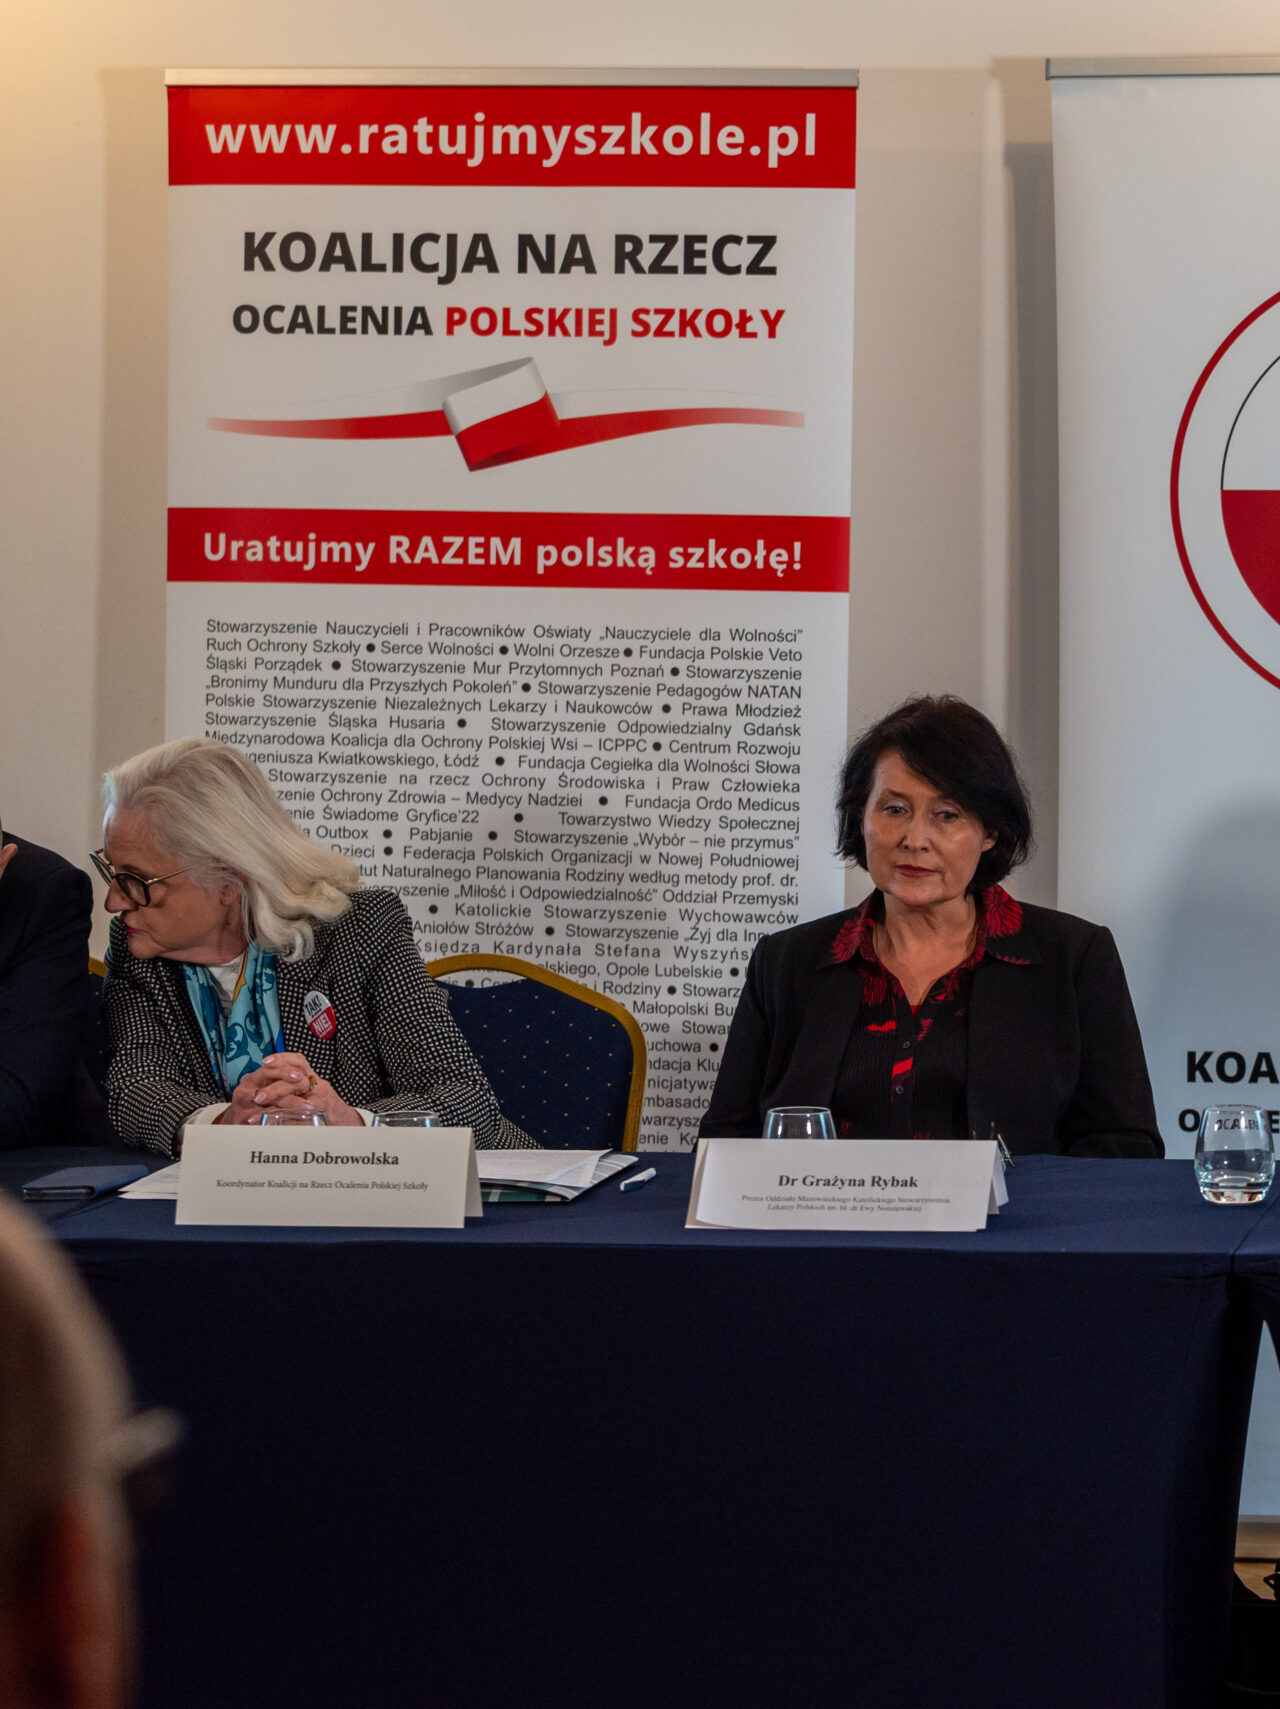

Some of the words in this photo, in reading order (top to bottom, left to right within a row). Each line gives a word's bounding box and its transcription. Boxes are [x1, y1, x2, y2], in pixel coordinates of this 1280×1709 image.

[204, 113, 818, 168] www.ratujmyszkole.pl
[243, 231, 500, 285] KOALICJA
[515, 233, 597, 276] NA
[613, 233, 778, 276] RZECZ
[232, 304, 433, 336] OCALENIA
[446, 306, 619, 346] POLSKIEJ
[630, 307, 786, 339] SZKOŁY
[203, 533, 376, 572] Uratujmy
[389, 535, 523, 566] RAZEM
[536, 537, 657, 576] polską
[667, 540, 803, 577] szkołę!
[207, 619, 317, 636] Stowarzyszenie
[326, 621, 408, 638] Nauczycieli
[429, 623, 525, 638] Pracowników
[534, 624, 591, 642] Oświaty
[700, 628, 720, 641] dla
[207, 638, 241, 651] Ruch
[247, 638, 308, 656] Ochrony
[313, 639, 361, 657] Szkoły
[381, 640, 423, 655] Serce
[428, 642, 494, 656] Wolności
[514, 643, 554, 656] Wolni
[560, 644, 620, 658] Orzesze
[640, 645, 704, 663] Fundacja
[711, 646, 763, 661] Polskie
[768, 648, 802, 662] Veto
[206, 654, 246, 673] Śląski
[255, 657, 322, 674] Porządek
[352, 658, 466, 676] Stowarzyszenie
[474, 661, 502, 674] Mur
[509, 662, 602, 680] Przytomnych
[611, 664, 664, 678] Poznań
[686, 665, 802, 683] Stowarzyszenie
[274, 676, 336, 690] Munduru
[342, 678, 364, 691] dla
[370, 678, 447, 695] Przyszłych
[538, 680, 651, 698] Stowarzyszenie
[657, 683, 742, 701] Pedagogów
[748, 685, 801, 699] NATAN
[206, 712, 316, 729] Stowarzyszenie
[328, 711, 377, 731] Śląska
[390, 716, 445, 730] Husaria
[491, 717, 606, 735] Stowarzyszenie
[618, 720, 732, 738] Odpowiedzialny
[744, 722, 801, 736] Gdańsk
[206, 730, 324, 748] Międzynarodowa
[331, 733, 388, 750] Koalicja
[394, 734, 415, 748] dla
[422, 734, 483, 752] Ochrony
[489, 736, 544, 754] Polskiej
[551, 737, 577, 750] Wsi
[599, 738, 647, 752] ICPPC
[669, 740, 730, 754] Centrum
[737, 741, 800, 758] Rozwoju
[318, 751, 438, 770] Kwiatkowskiego,
[444, 754, 479, 768] Łódź
[518, 755, 585, 773] Fundacja
[590, 756, 652, 774] Cegiełka
[658, 758, 678, 772] dla
[684, 759, 749, 773] Wolności
[755, 760, 800, 774] Słowa
[268, 768, 387, 786] Stowarzyszenie
[400, 774, 417, 784] na
[430, 775, 469, 786] rzecz
[482, 773, 546, 791] Ochrony
[558, 772, 644, 790] Środowiska
[672, 777, 710, 791] Praw
[722, 778, 800, 793] Człowieka
[322, 804, 398, 822] Świadome
[558, 812, 651, 830] Towarzystwo
[658, 814, 711, 832] Wiedzy
[719, 816, 799, 834] Społecznej
[316, 825, 368, 839] Outbox
[410, 827, 472, 844] Pabjanie
[514, 829, 628, 847] Stowarzyszenie
[704, 834, 726, 848] nie
[404, 846, 475, 864] Federacja
[483, 848, 543, 862] Polskich
[551, 849, 632, 867] Organizacji
[640, 854, 651, 864] w
[659, 852, 702, 869] Nowej
[710, 853, 798, 871] Południowej
[456, 902, 531, 918] Katolickie
[544, 905, 666, 923] Stowarzyszenie
[679, 908, 798, 924] Wychowawców
[413, 920, 470, 935] Aniołów
[475, 922, 534, 936] Stróżów
[566, 924, 678, 942] Stowarzyszenie
[716, 928, 738, 942] dla
[494, 940, 582, 958] Kardynała
[595, 943, 660, 958] Stefana
[606, 962, 649, 978] Opole
[655, 963, 723, 979] Lubelskie
[603, 981, 661, 998] Rodziny
[633, 1000, 709, 1017] Małopolski
[250, 1151, 298, 1164] Hanna
[302, 1151, 399, 1165] Dobrowolska
[778, 1174, 799, 1187] Dr
[802, 1174, 865, 1190] Grażyna
[871, 1175, 918, 1190] Rybak
